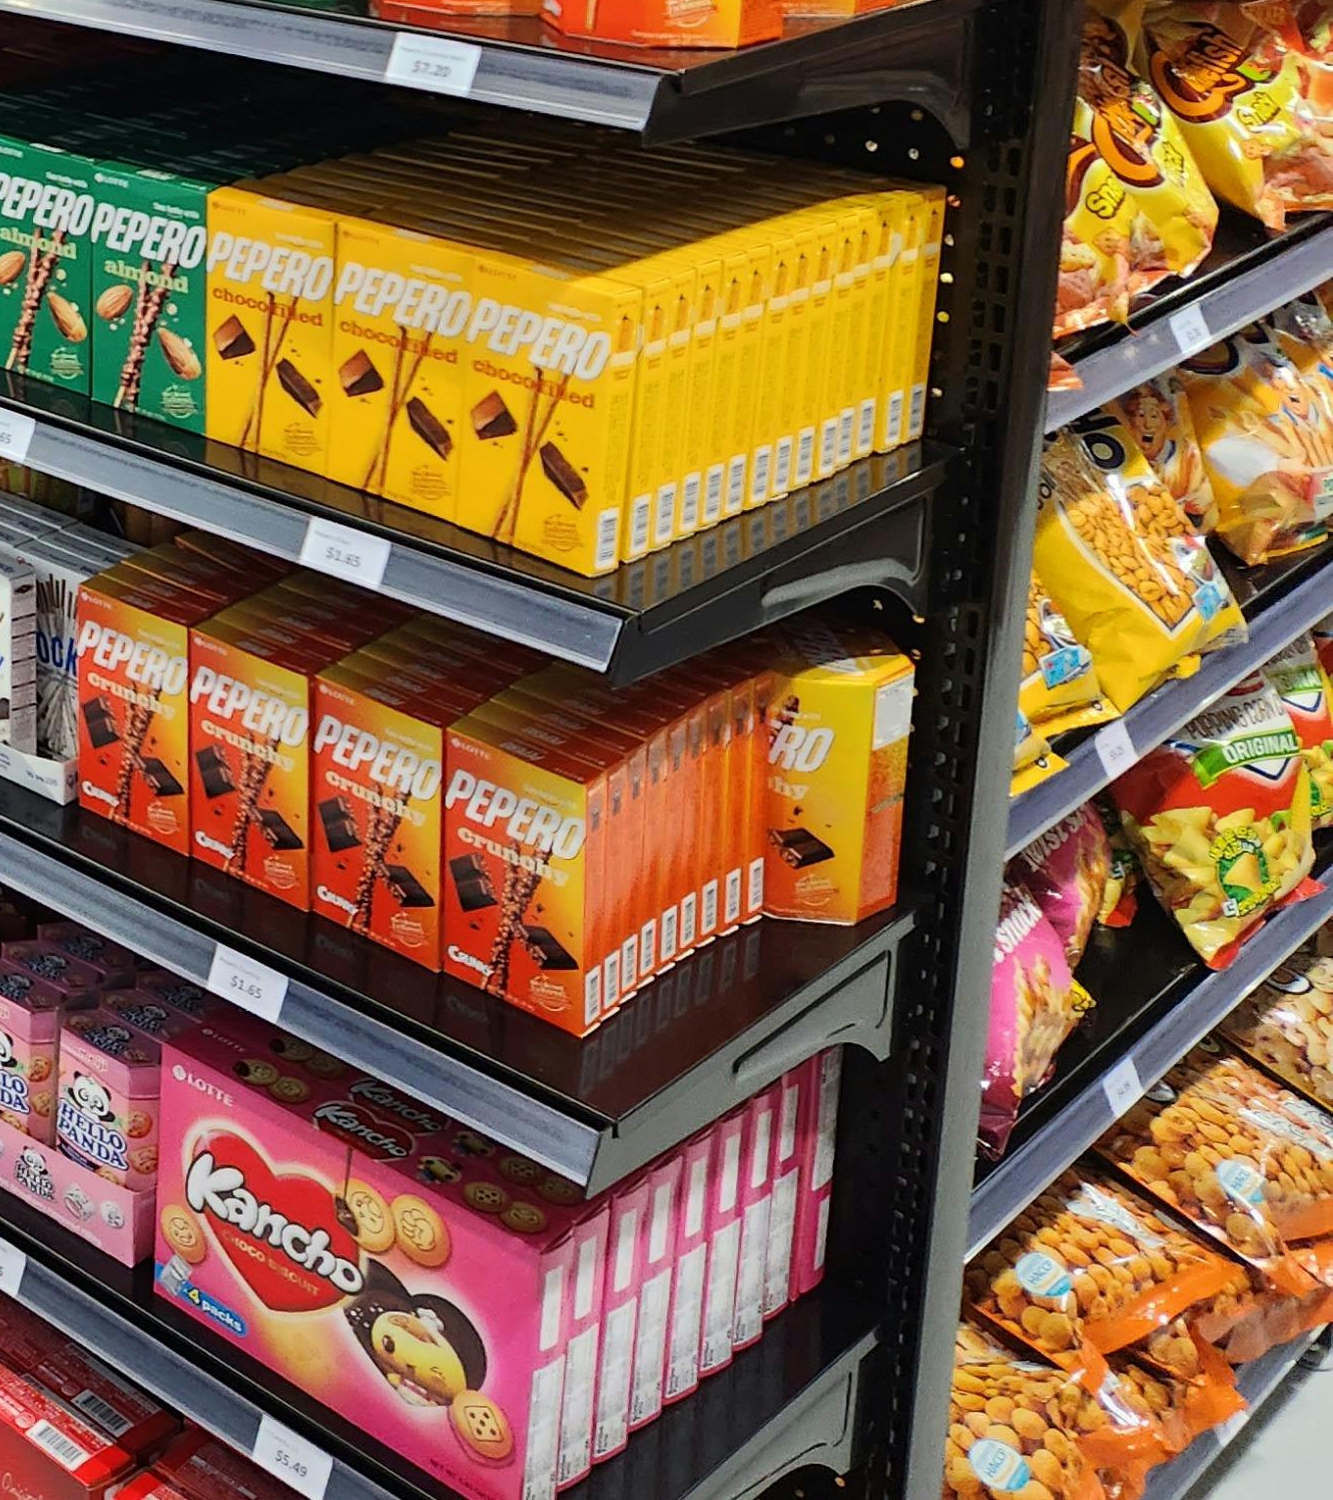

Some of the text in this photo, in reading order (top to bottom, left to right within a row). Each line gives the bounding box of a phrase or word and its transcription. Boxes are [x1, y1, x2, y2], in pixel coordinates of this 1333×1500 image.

[91, 202, 207, 270] PEPERO
[103, 258, 189, 294] almond
[207, 231, 335, 303] PEPERO
[333, 260, 473, 340] PEPERO
[466, 298, 613, 382] PEPERO
[324, 543, 363, 570] $1.65
[77, 619, 189, 697] PEPERO
[87, 671, 176, 721] crunchy
[189, 665, 310, 747] PEPERO
[201, 718, 295, 774] crunchy
[314, 714, 443, 802] PEPERO
[460, 741, 492, 761] LOTTE
[1221, 731, 1299, 764] ORIGINAL
[325, 769, 428, 828] crunchy
[444, 768, 586, 860] PEPERO
[456, 826, 570, 888] crunchy
[229, 973, 264, 1001] $1.65
[186, 1072, 234, 1108] LOTTE
[57, 1118, 130, 1172] PANDA
[60, 1101, 127, 1150] HELLO
[314, 1105, 410, 1159] Kancho
[185, 1150, 366, 1297] Kancho
[220, 1228, 321, 1297] CHOCO BISCUIT
[1027, 1259, 1056, 1288] HACCP
[187, 1285, 244, 1335] 4 packs
[273, 1449, 309, 1480] $5.49
